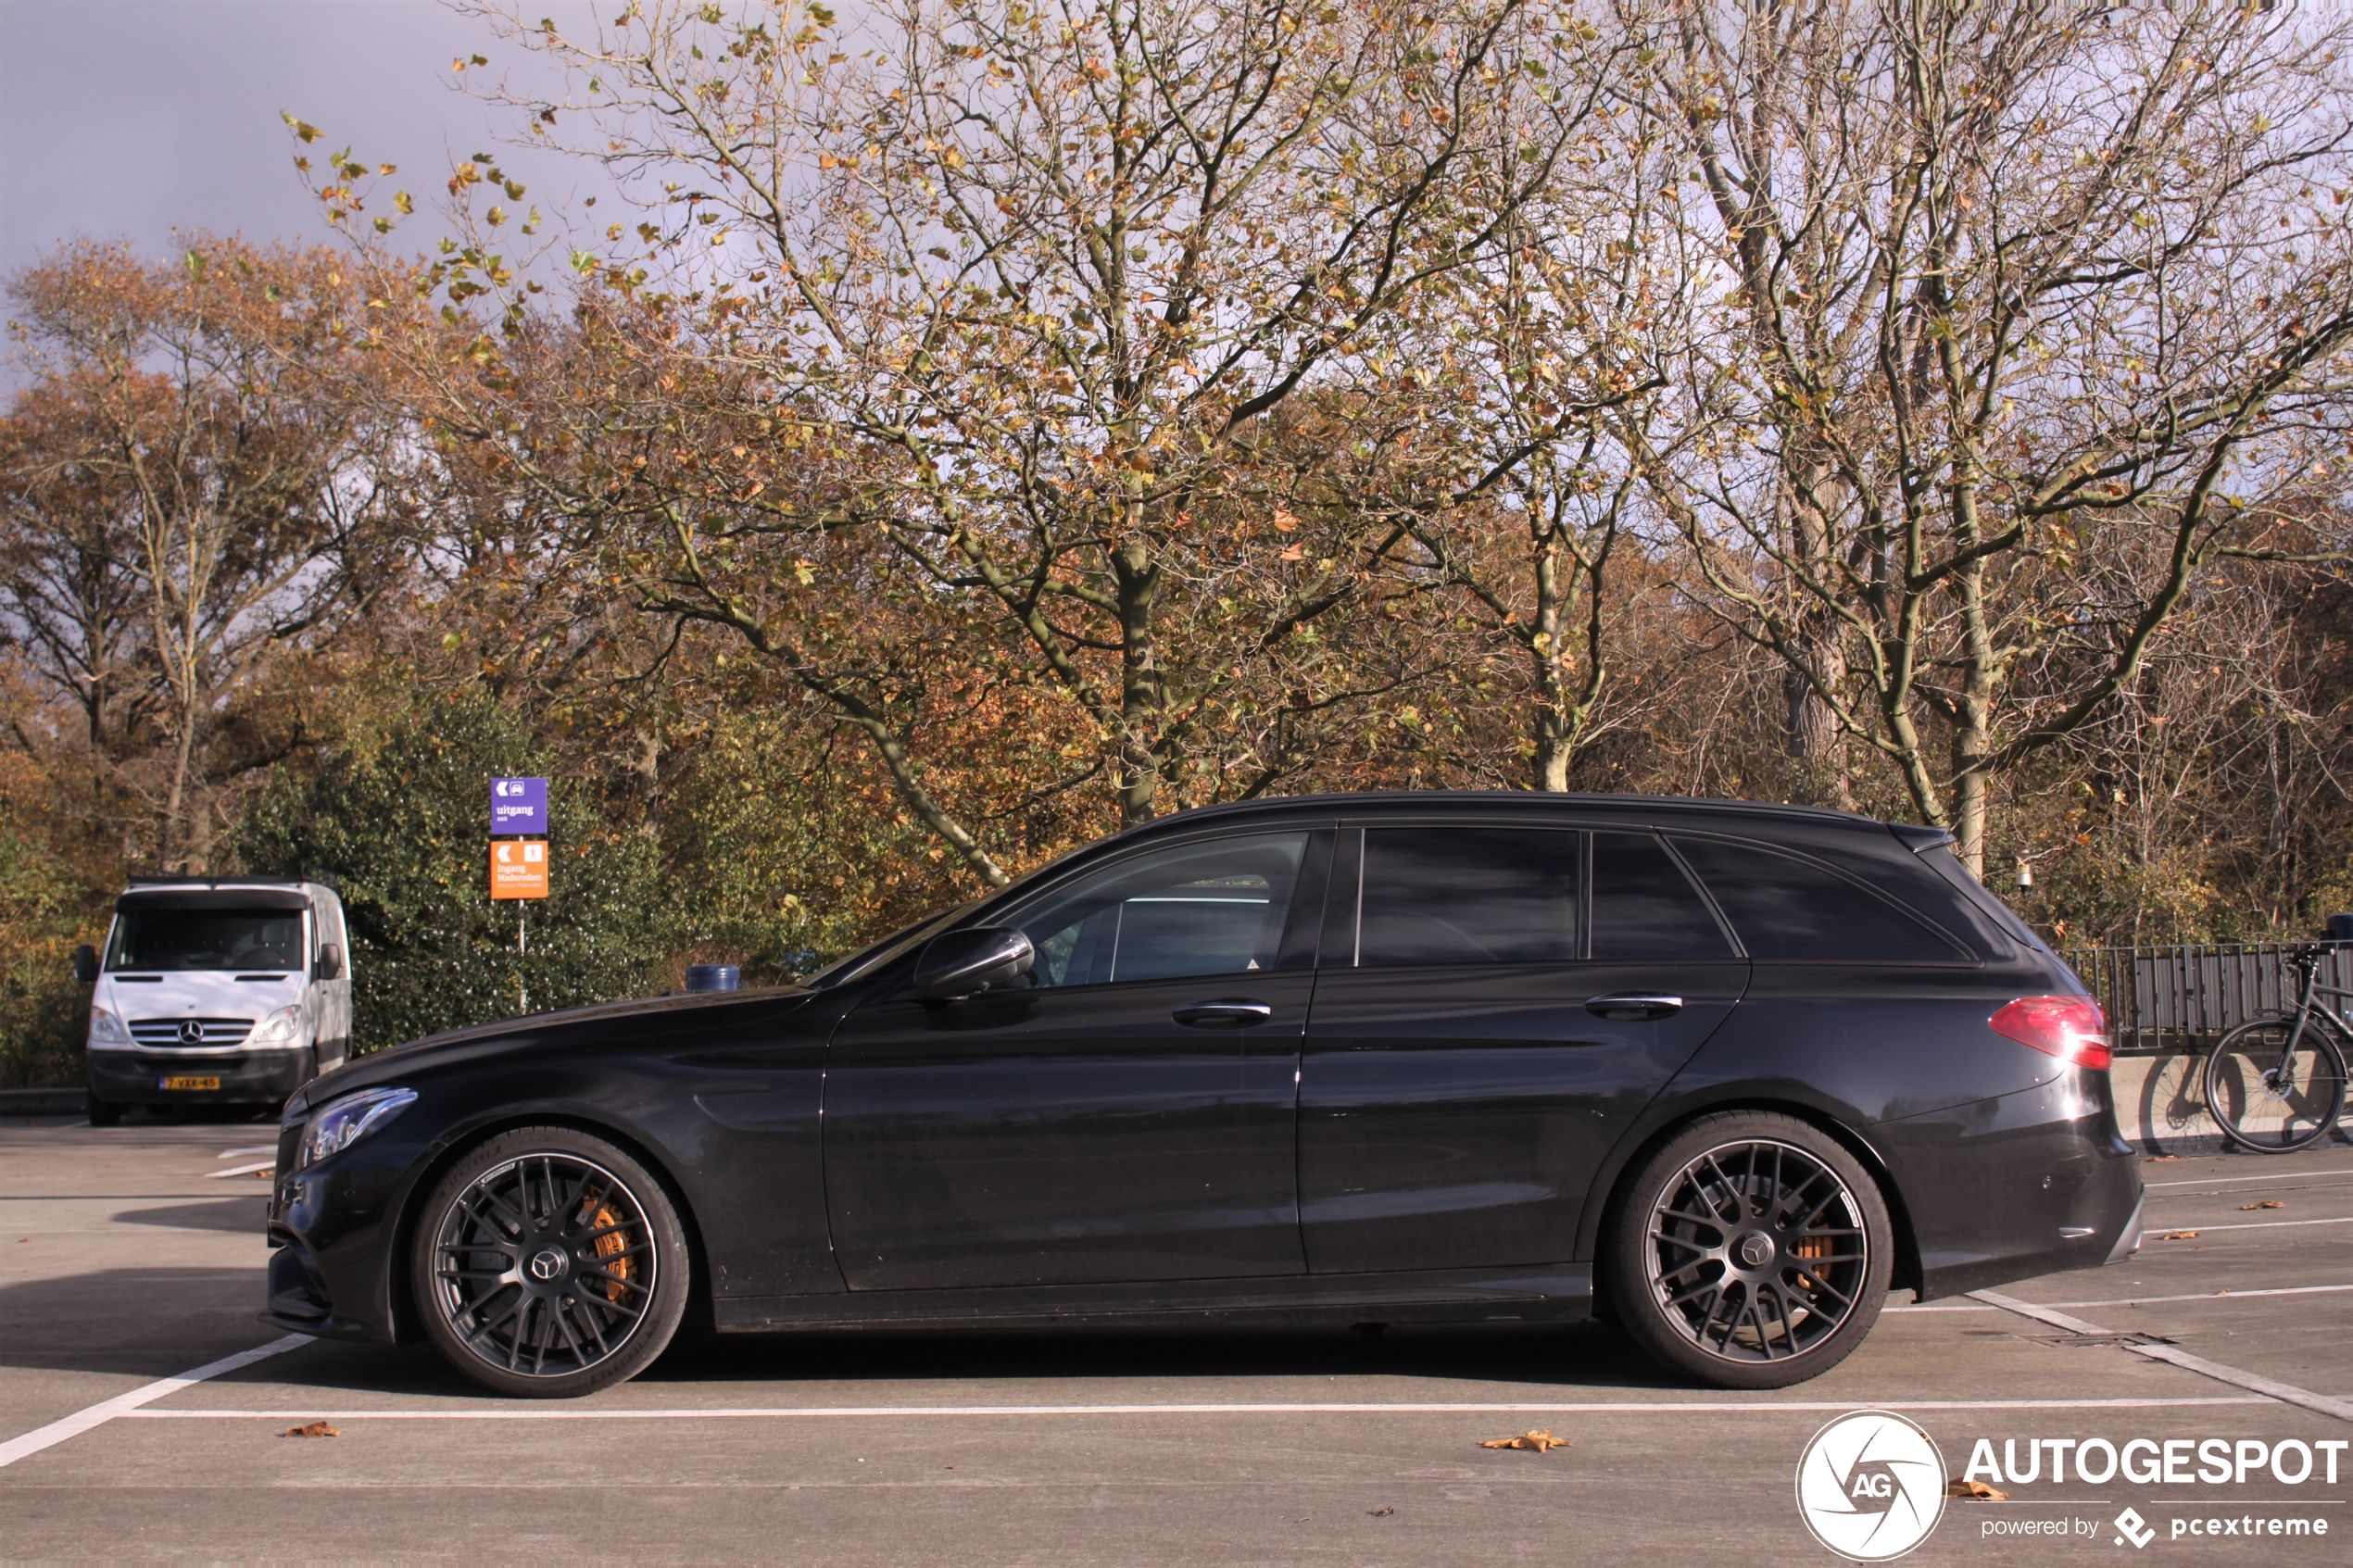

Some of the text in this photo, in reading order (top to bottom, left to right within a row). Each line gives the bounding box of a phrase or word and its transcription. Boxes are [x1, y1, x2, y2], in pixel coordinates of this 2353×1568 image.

[497, 805, 534, 816] uitgang
[497, 865, 526, 874] Ingang
[497, 873, 543, 882] Madurodam
[167, 1077, 216, 1088] 7-VXK-45
